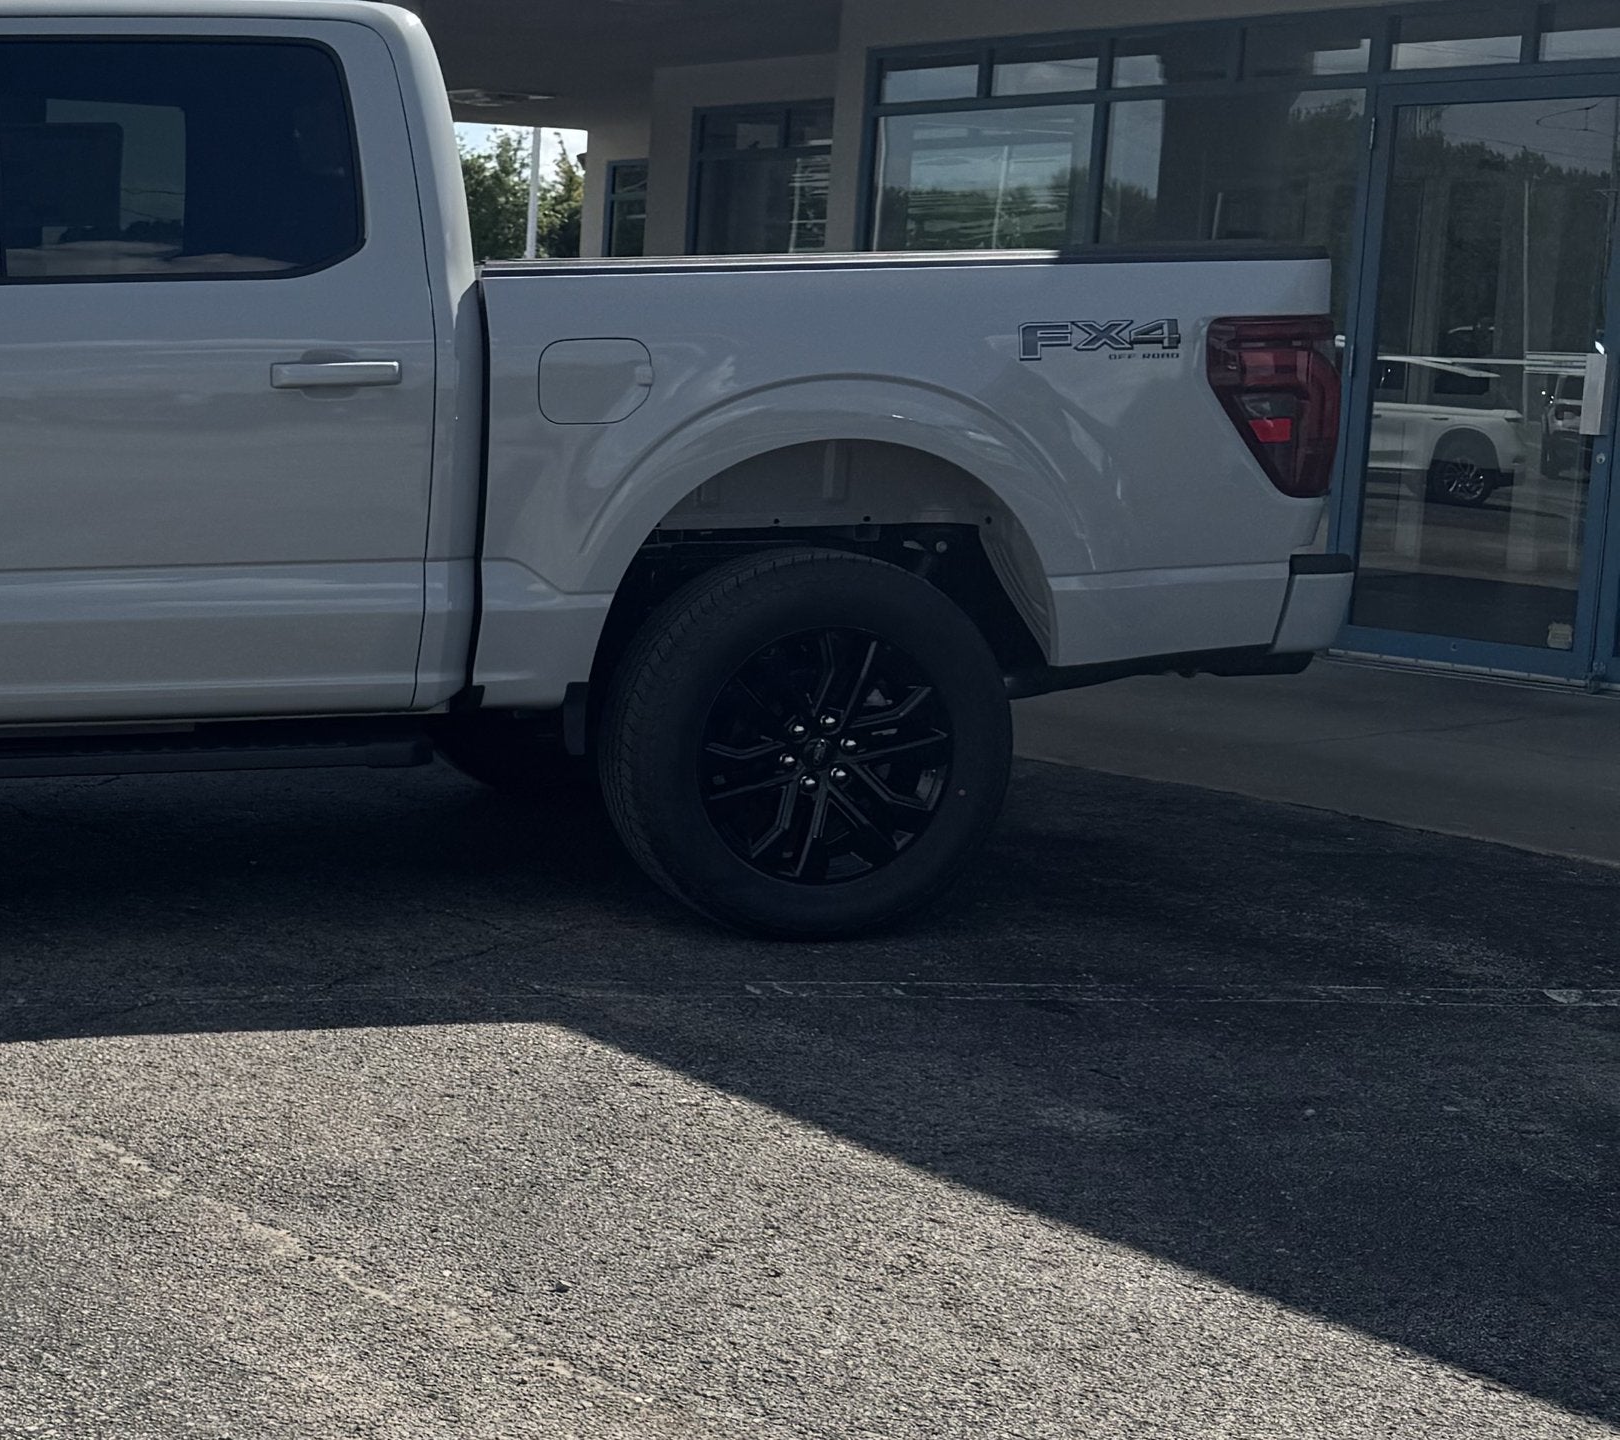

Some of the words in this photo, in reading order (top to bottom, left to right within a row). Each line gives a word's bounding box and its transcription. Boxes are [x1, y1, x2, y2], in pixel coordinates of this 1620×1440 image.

[1018, 319, 1181, 361] FX4
[1108, 352, 1136, 360] OFF
[1142, 351, 1180, 360] ROAD
